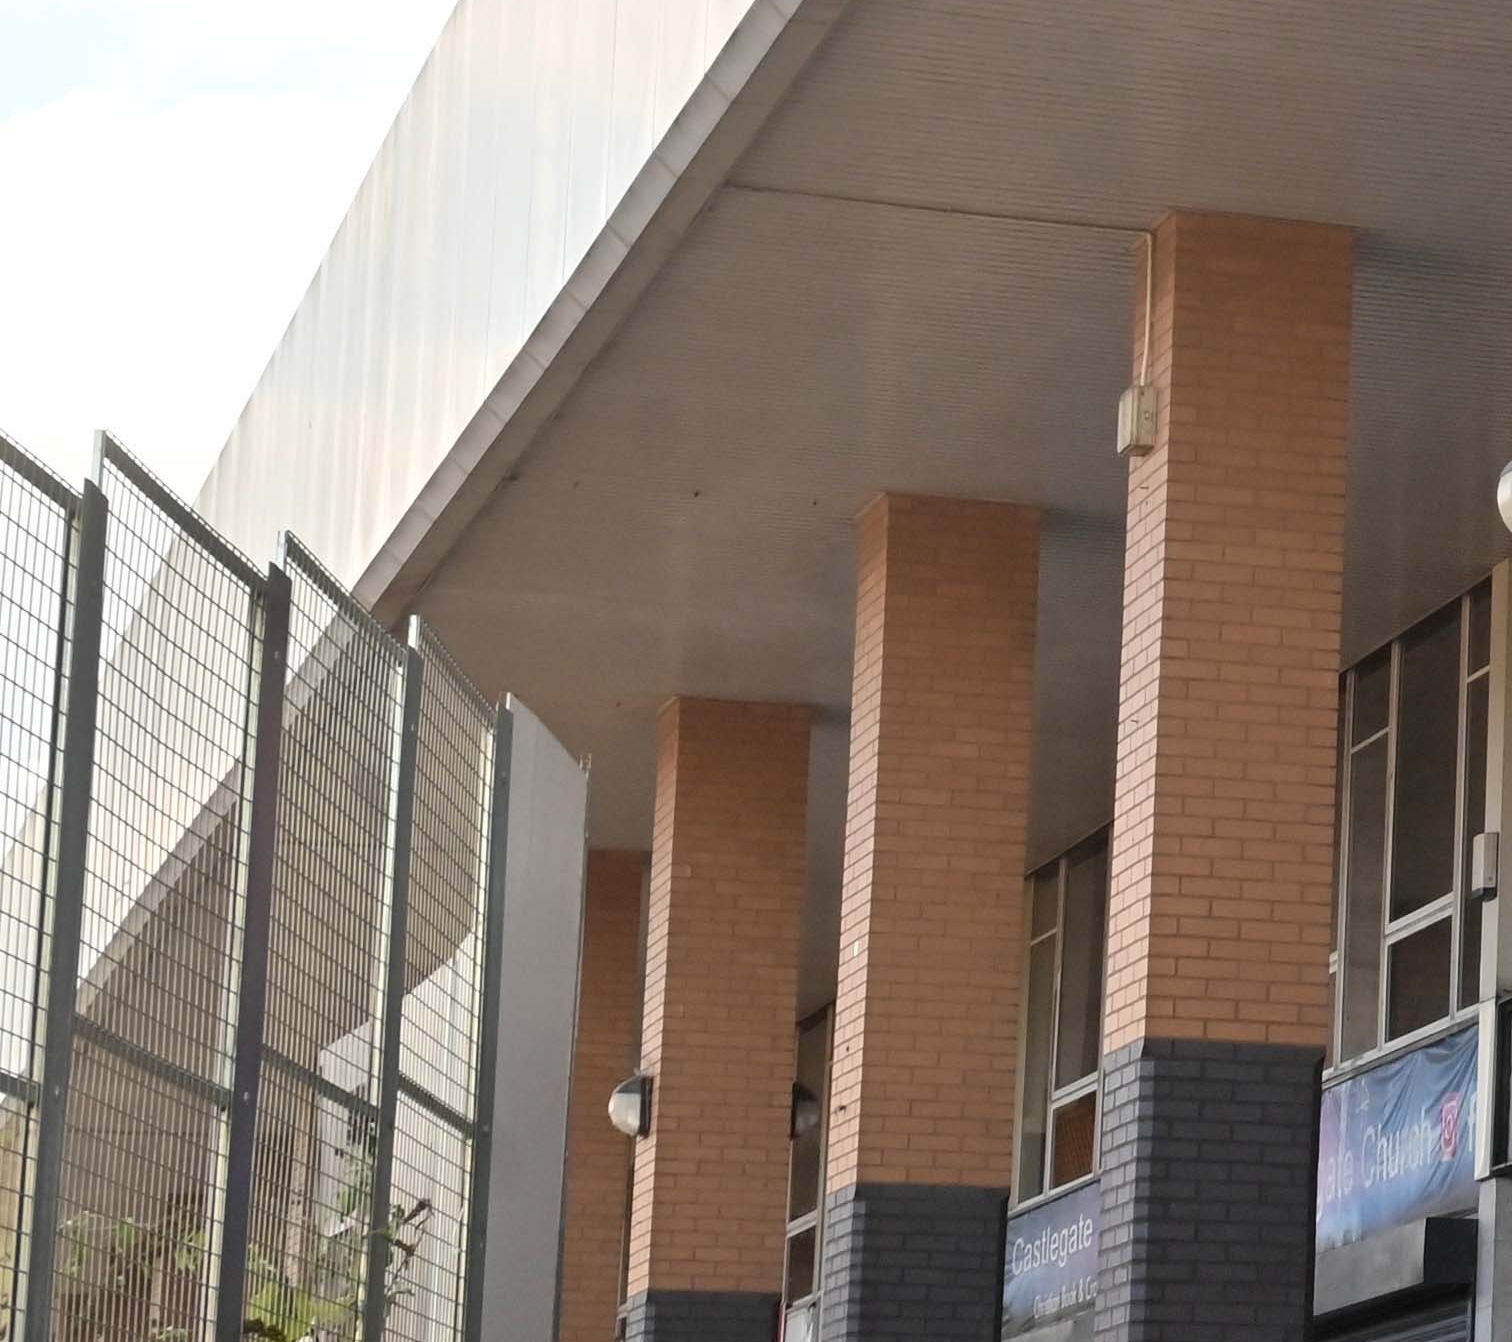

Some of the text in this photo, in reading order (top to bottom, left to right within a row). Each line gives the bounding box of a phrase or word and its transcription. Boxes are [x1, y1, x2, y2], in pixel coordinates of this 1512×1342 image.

[1316, 1107, 1433, 1224] ate Church
[1012, 1212, 1093, 1275] Castlegate
